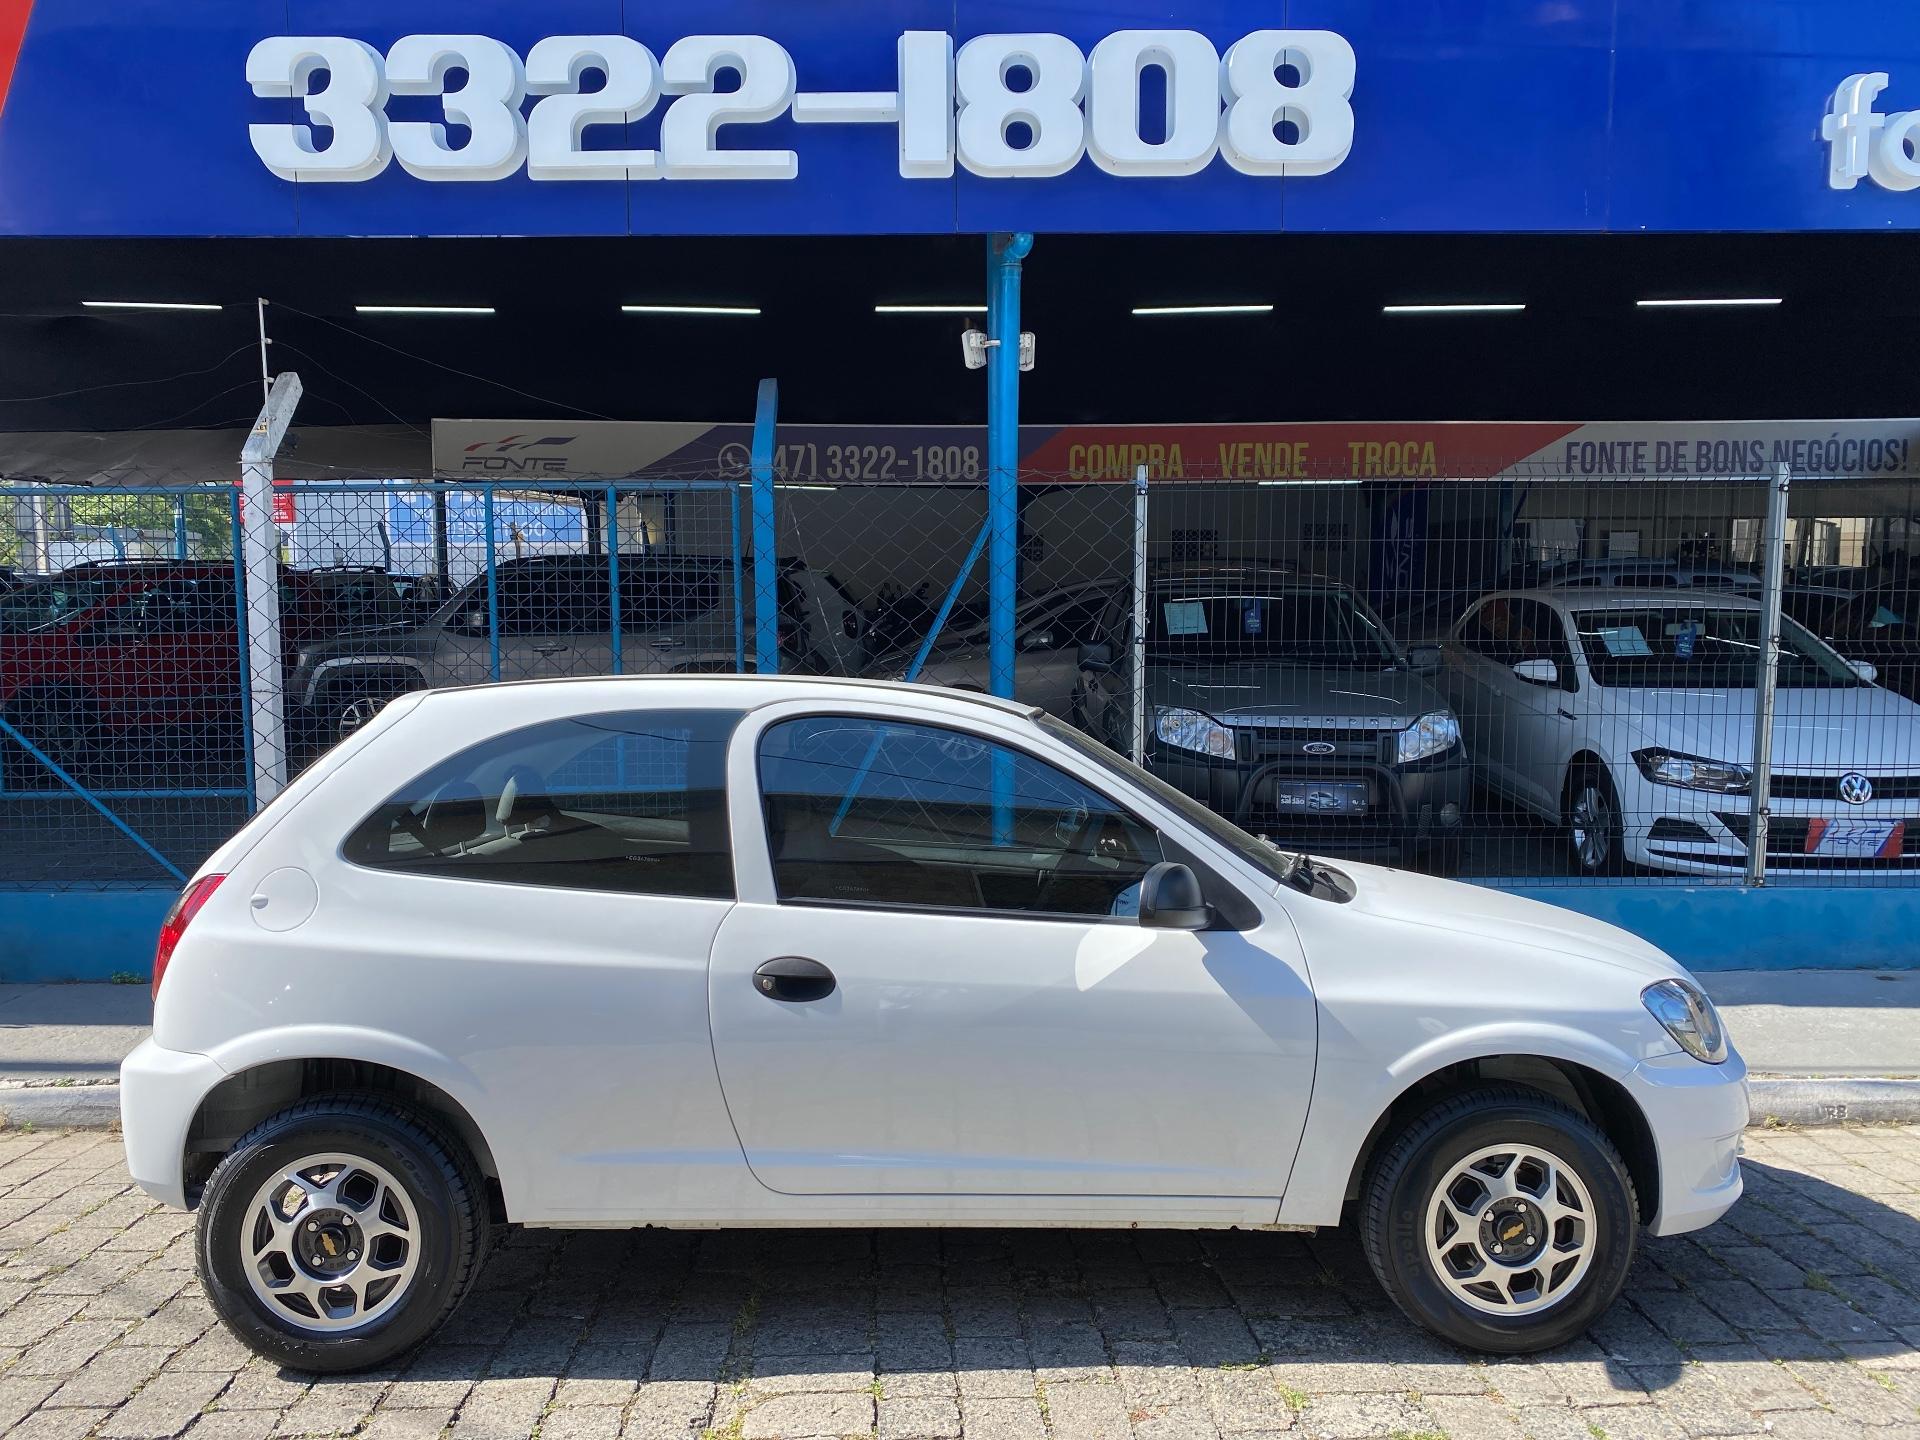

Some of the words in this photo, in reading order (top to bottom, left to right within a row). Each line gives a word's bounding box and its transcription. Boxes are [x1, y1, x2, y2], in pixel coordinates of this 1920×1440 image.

[246, 29, 1356, 183] 3322-1808
[463, 456, 568, 471] FONTE
[774, 444, 817, 481] 47)
[826, 445, 979, 480] 3322-1808
[1068, 443, 1184, 480] COMPRA
[1219, 442, 1310, 478] VENDE
[1348, 441, 1437, 477] TROCA
[1565, 441, 1648, 474] FONTE
[1655, 440, 1689, 474] DE
[1695, 439, 1765, 473] BONS
[1773, 432, 1909, 472] NEGÓCIOS!
